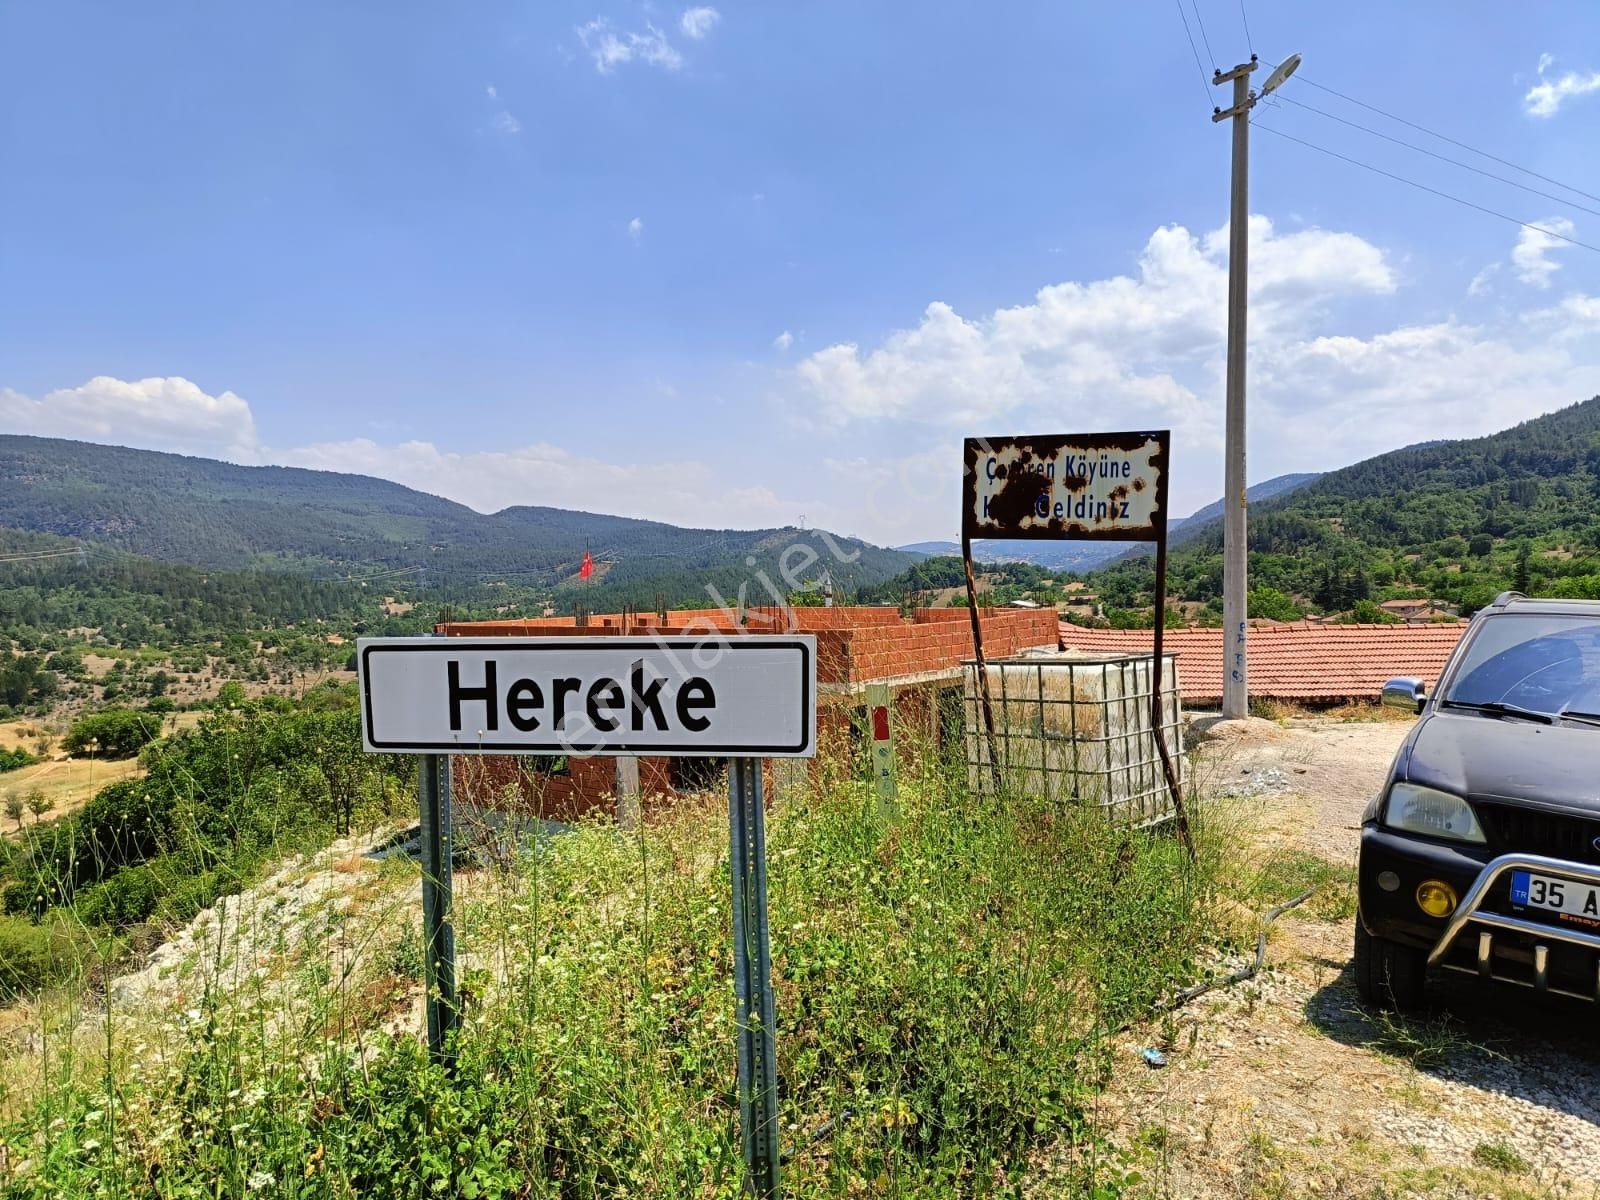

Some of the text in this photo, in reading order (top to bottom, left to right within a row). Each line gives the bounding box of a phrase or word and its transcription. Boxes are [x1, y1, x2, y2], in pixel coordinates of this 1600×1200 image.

[1066, 455, 1130, 485] Köyüne
[447, 658, 716, 733] Hereke
[1514, 889, 1527, 899] TR
[1530, 879, 1598, 916] 35 A
